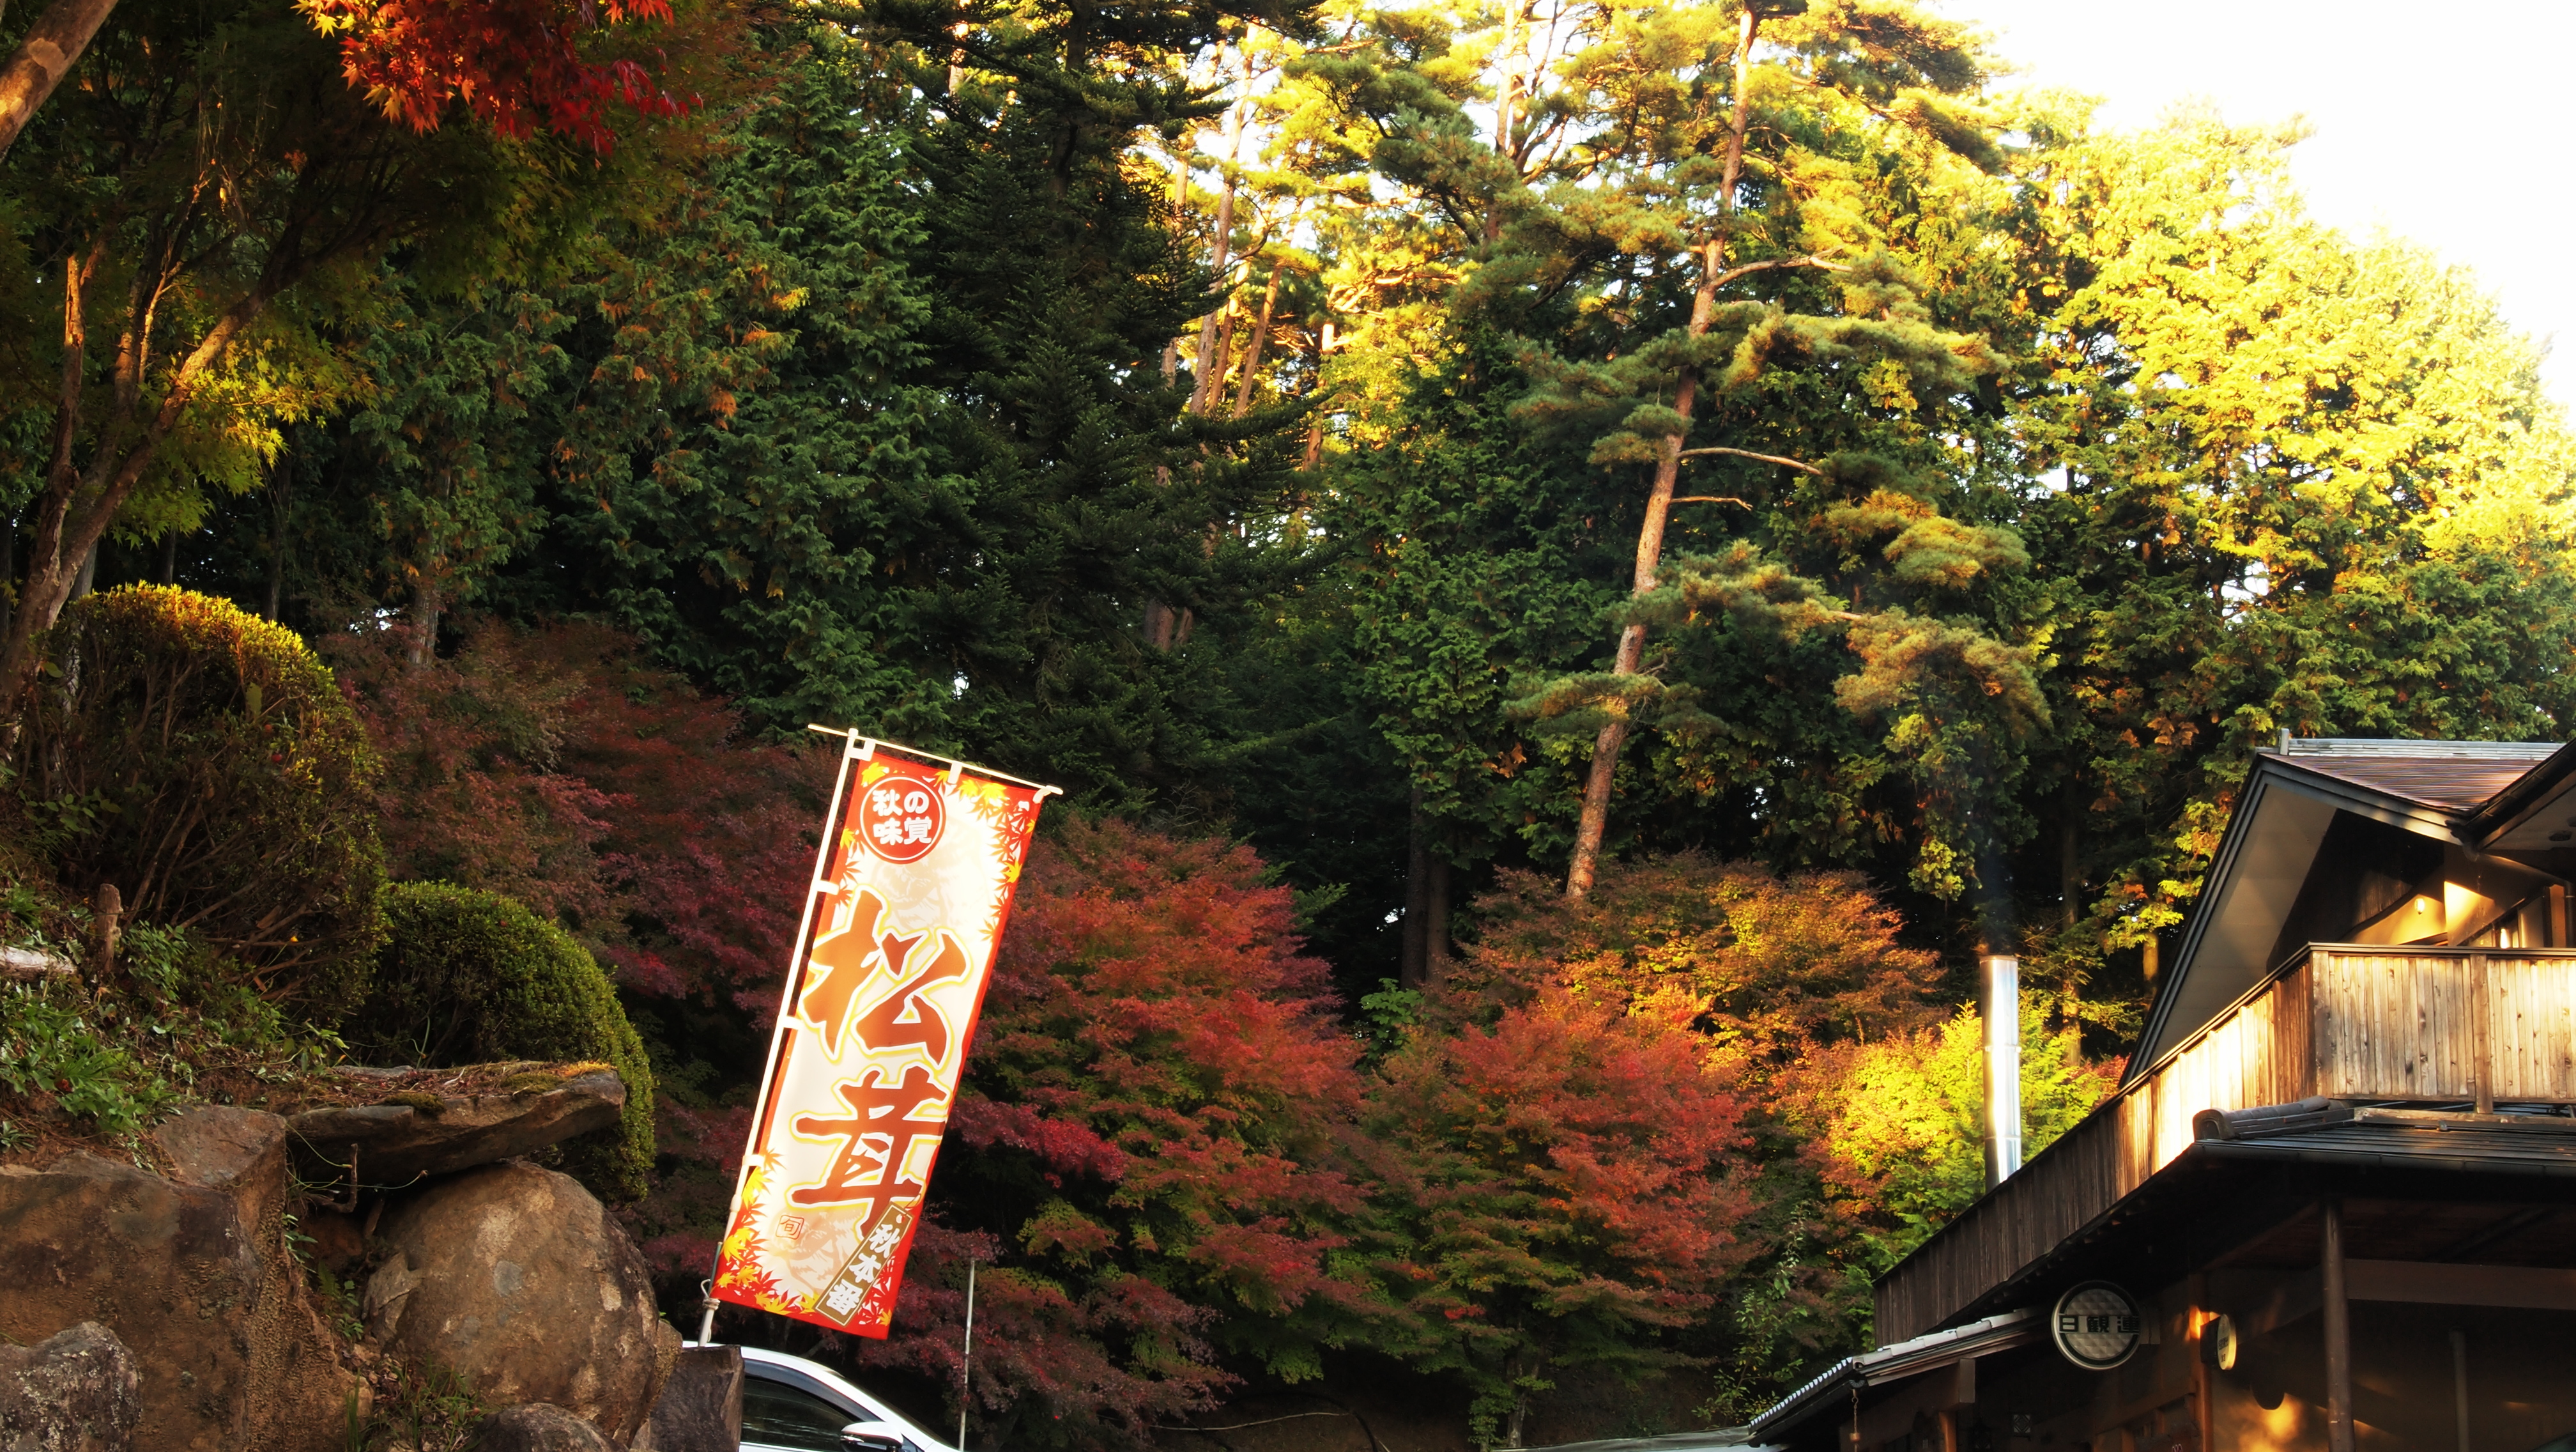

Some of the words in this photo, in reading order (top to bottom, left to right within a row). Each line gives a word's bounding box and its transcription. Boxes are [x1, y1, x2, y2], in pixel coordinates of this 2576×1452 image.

[872, 789, 930, 816] 秋の
[872, 816, 932, 846] 味覚
[792, 887, 969, 1242] 松茸
[779, 1217, 802, 1237] 旬
[825, 1223, 900, 1316] 秋本番
[2059, 1315, 2140, 1334] 日観連
